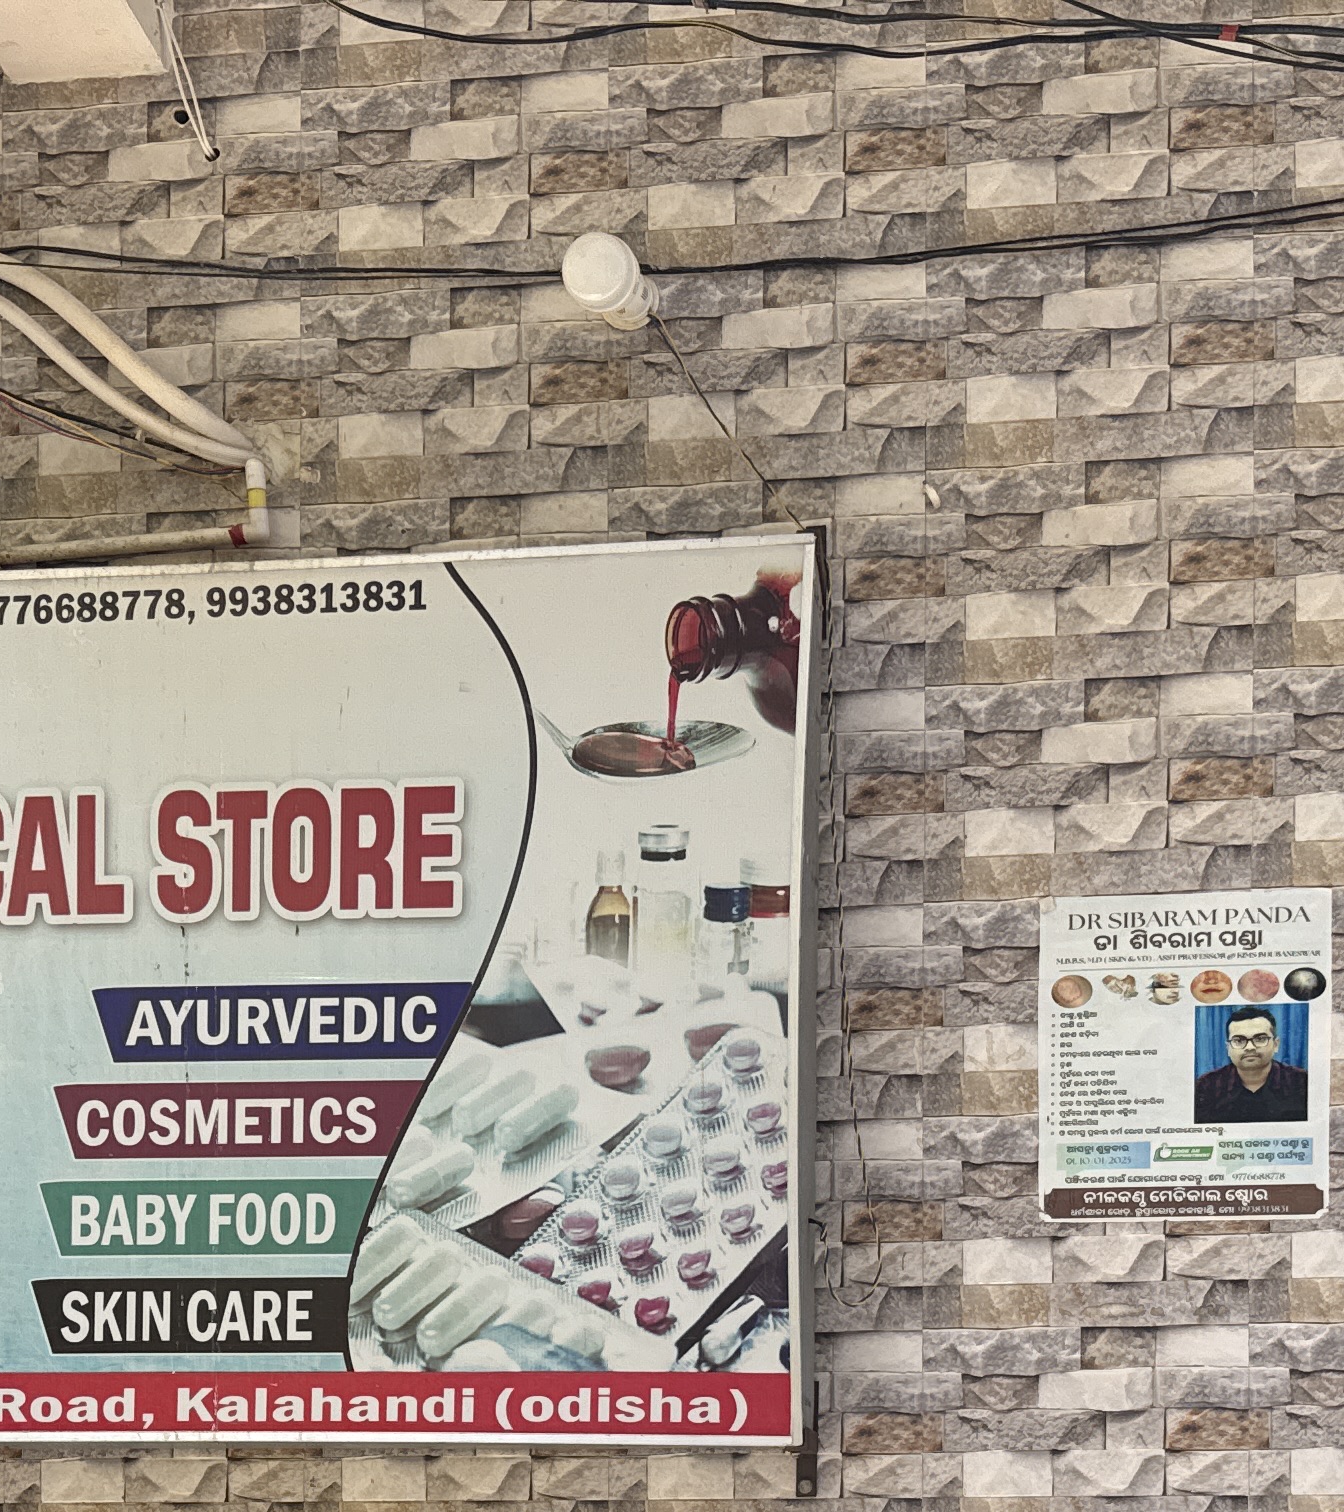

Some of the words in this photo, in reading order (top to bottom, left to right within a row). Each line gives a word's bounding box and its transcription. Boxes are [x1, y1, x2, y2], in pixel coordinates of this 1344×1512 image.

[208, 580, 427, 618] 9938313831
[152, 774, 466, 926] STORE
[1068, 913, 1103, 930] DR
[1108, 908, 1216, 929] SIBARAM
[1225, 906, 1310, 925] PANDA
[1094, 935, 1117, 950] ଡା
[1130, 929, 1211, 950] ଶିବରାମ
[1219, 929, 1263, 950] ପଣ୍ଡା
[125, 994, 438, 1047] AYURVEDIC
[76, 1095, 378, 1147] COSMETICS
[70, 1194, 202, 1247] BABY
[209, 1192, 336, 1245] FOOD
[1083, 1190, 1146, 1207] ନୀଳକଣ୍ଠ
[1150, 1187, 1221, 1202] ମେଡିକାଲ
[60, 1289, 173, 1344] SKIN
[185, 1289, 313, 1342] CARE
[177, 1387, 476, 1423] Kalahandi
[494, 1386, 750, 1431] (odisha)
